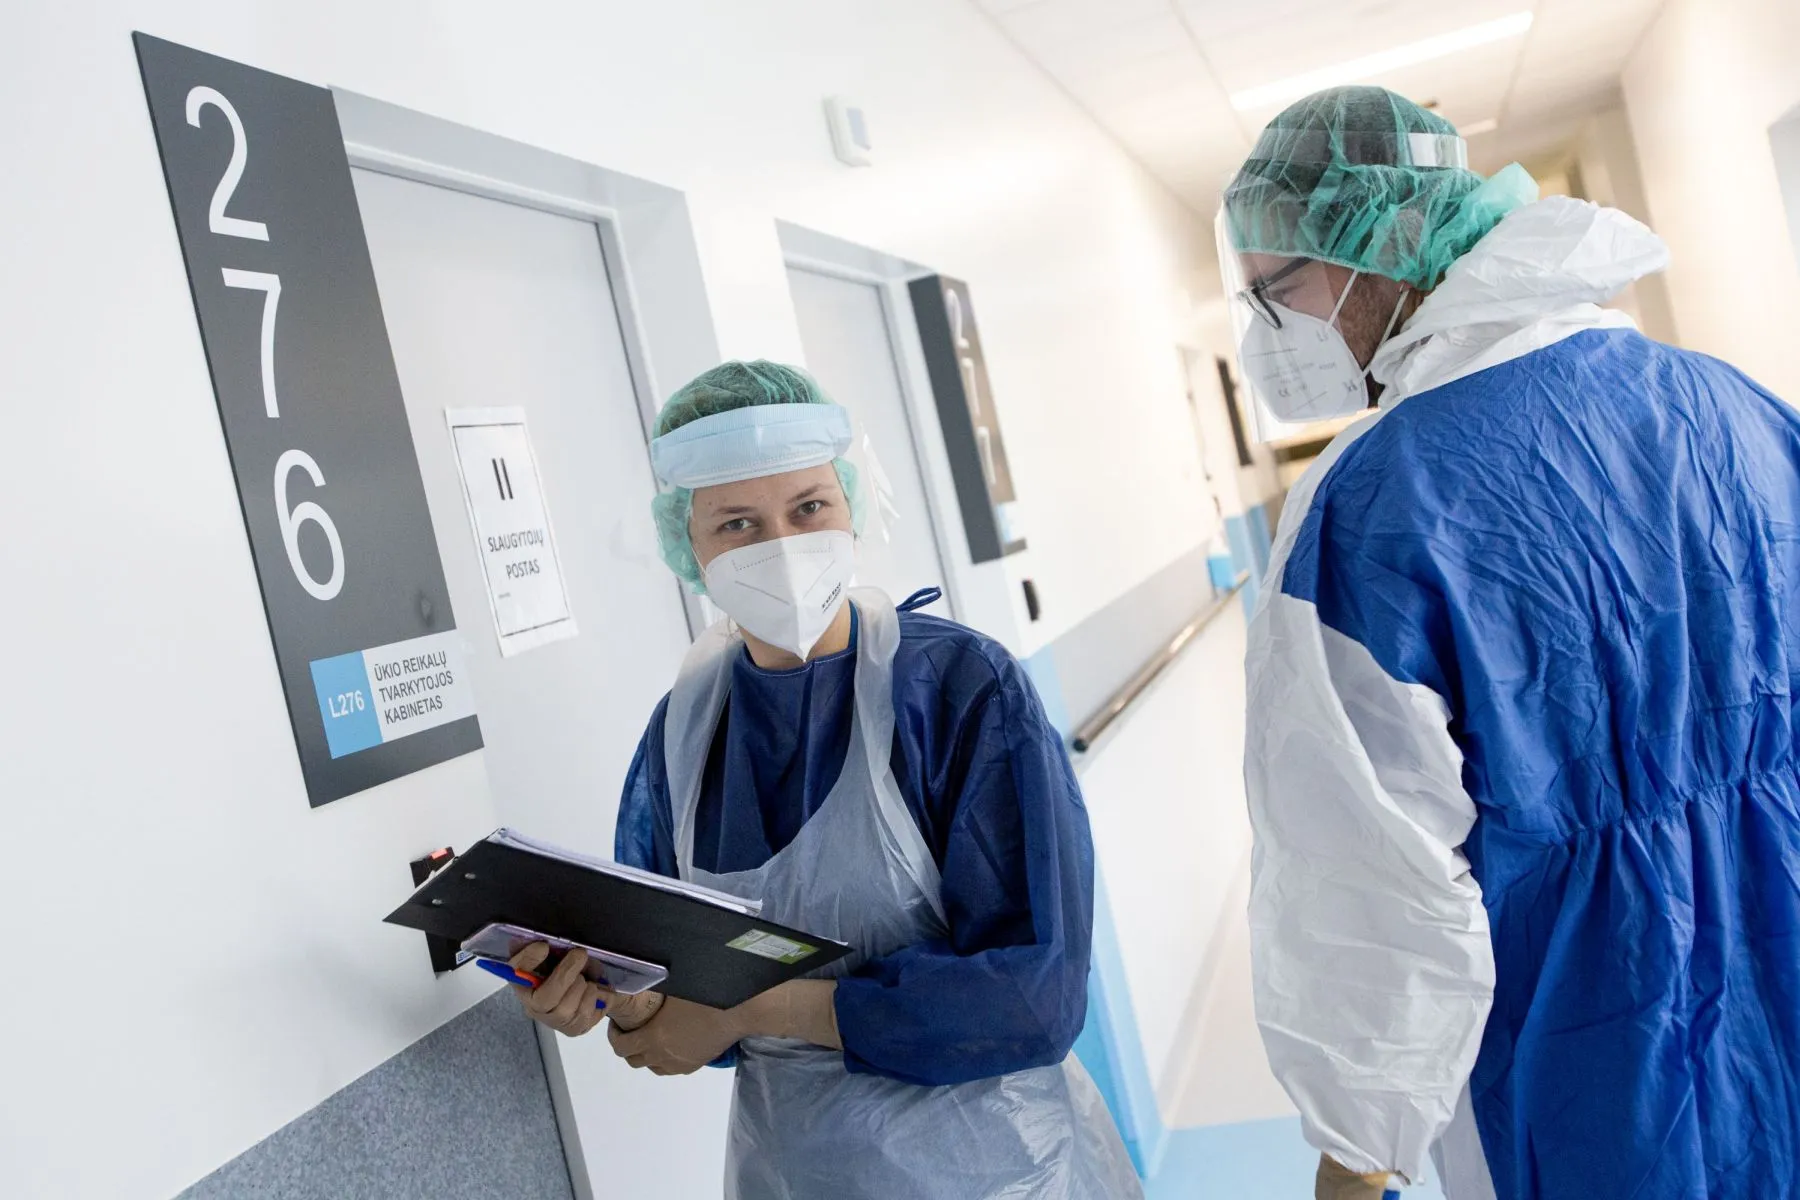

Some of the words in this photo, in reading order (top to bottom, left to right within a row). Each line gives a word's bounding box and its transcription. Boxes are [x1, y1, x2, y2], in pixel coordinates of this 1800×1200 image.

[186, 86, 345, 601] 276
[487, 529, 545, 553] SLAUGYTOJŲ
[505, 558, 541, 580] POSTAS
[374, 661, 402, 682] ŪKIO
[402, 650, 447, 675] REIKALŲ
[378, 671, 454, 703] TVARKYTOJOS
[328, 689, 366, 719] L276
[384, 695, 443, 725] KABINETAS
